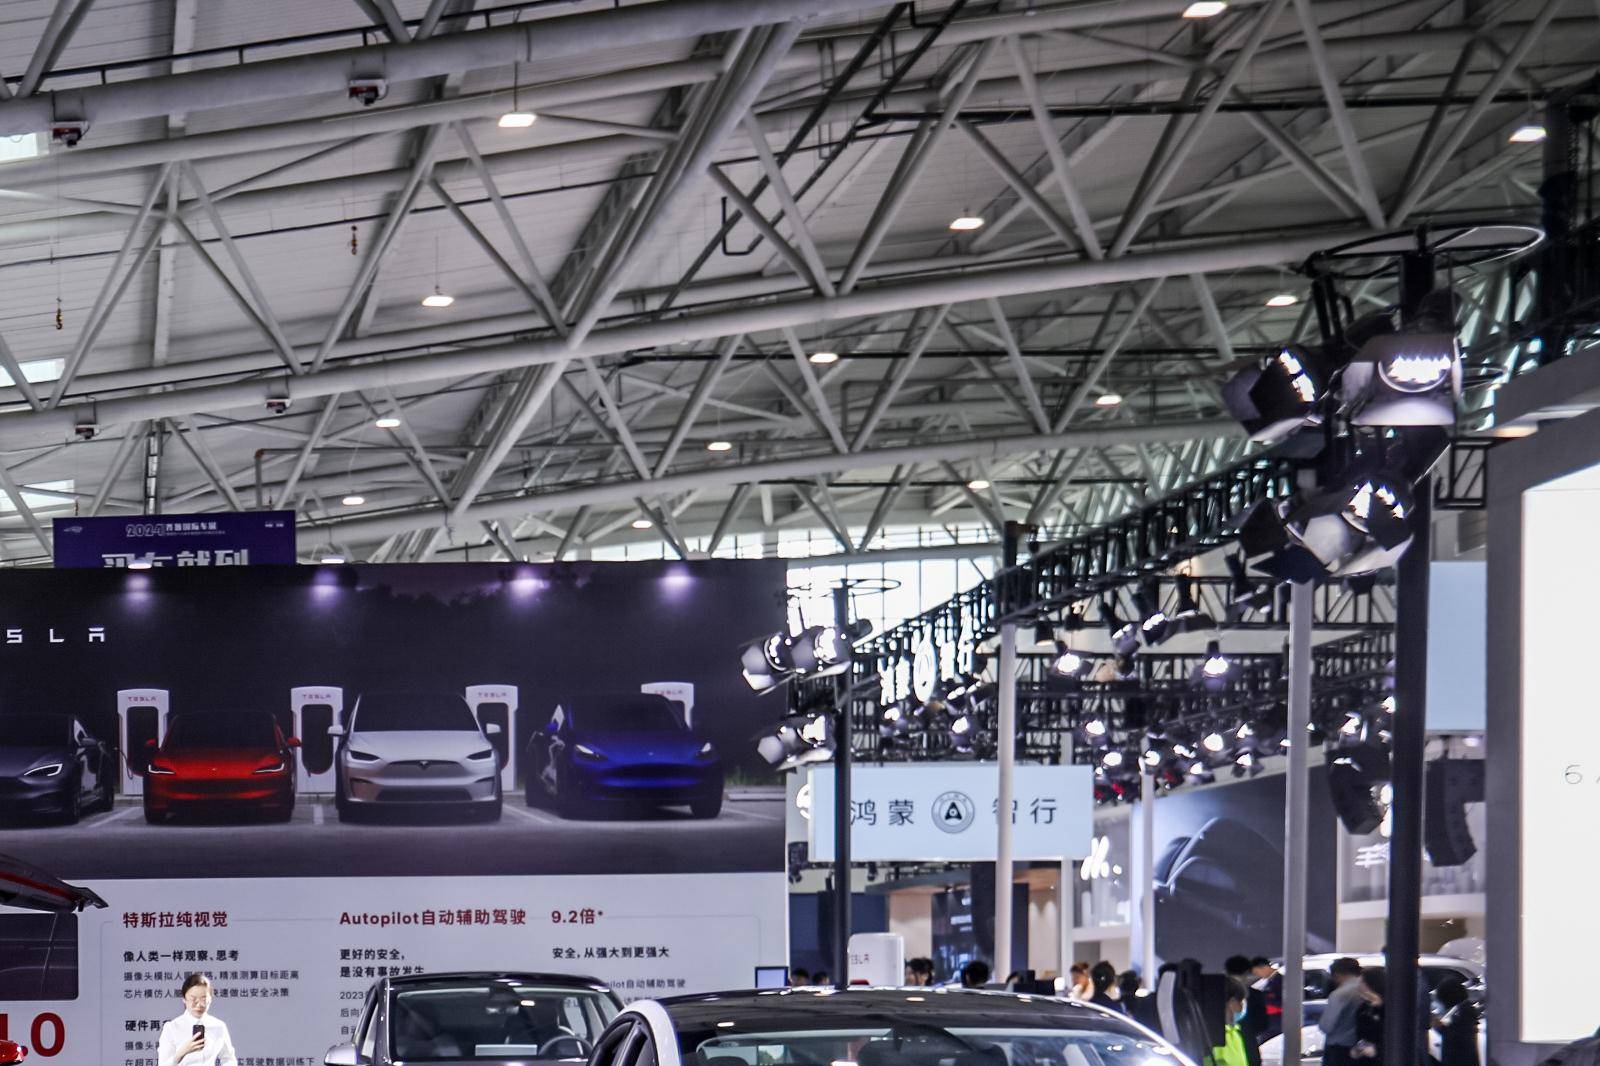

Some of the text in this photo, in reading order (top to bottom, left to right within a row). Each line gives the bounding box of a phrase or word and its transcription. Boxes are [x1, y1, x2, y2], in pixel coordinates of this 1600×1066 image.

[850, 799, 915, 826] 鸿蒙
[122, 911, 229, 929] 特斯拉纯视觉
[339, 908, 527, 928] Autopilot自动辅助驾驶
[123, 950, 240, 963] 像人类一样观察、思考
[339, 991, 369, 1000] 2023
[125, 1019, 171, 1032] 硬件再
